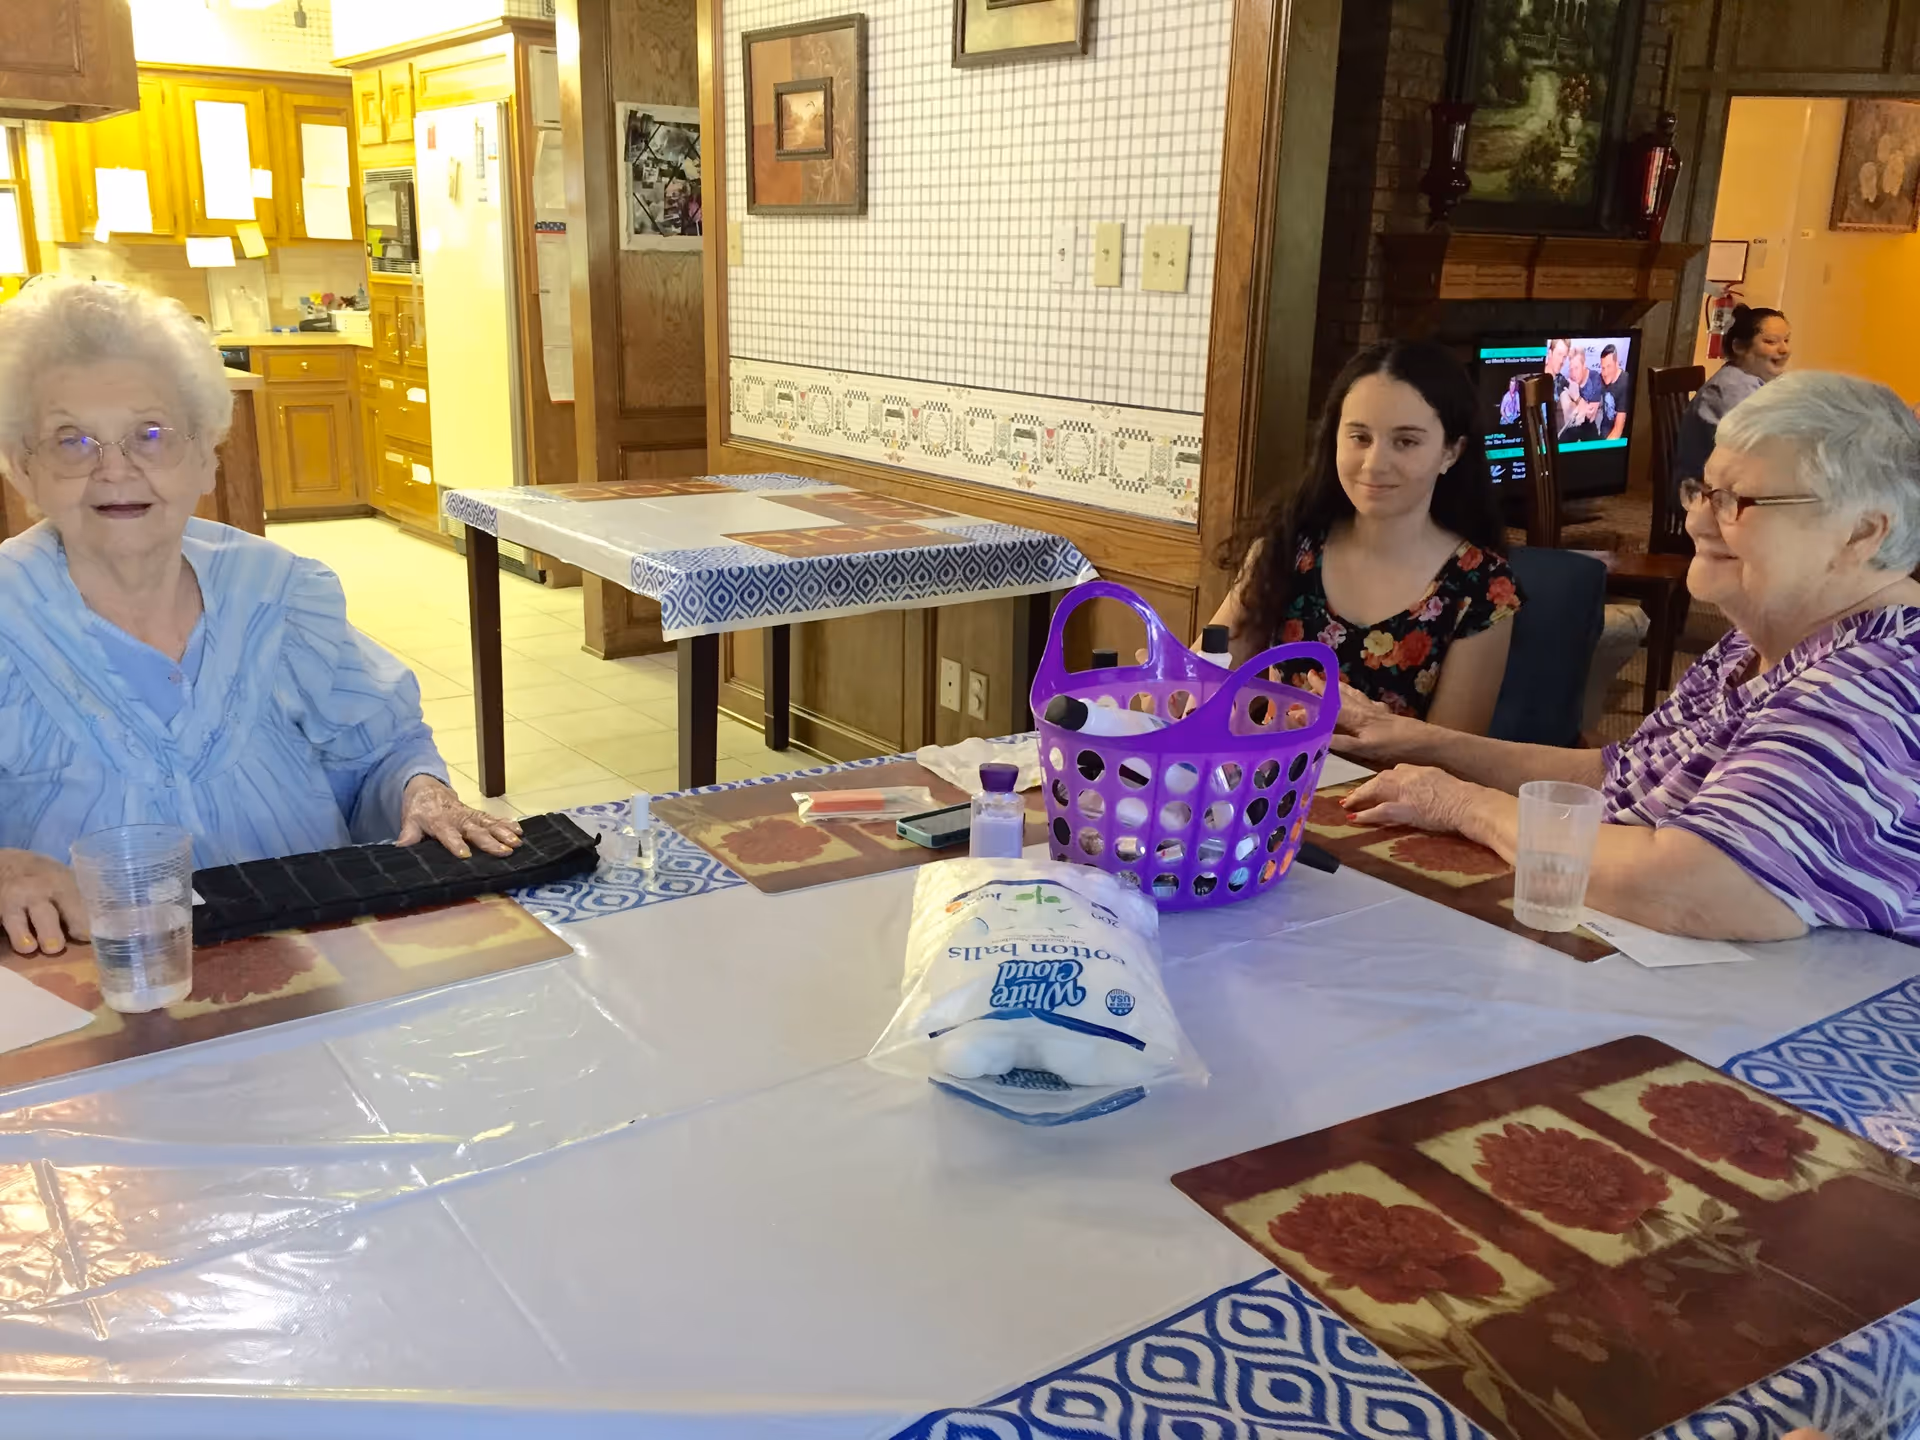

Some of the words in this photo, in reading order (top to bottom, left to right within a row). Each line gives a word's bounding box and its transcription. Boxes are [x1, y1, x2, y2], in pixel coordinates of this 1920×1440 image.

[947, 944, 1018, 961] balls
[1029, 943, 1125, 965] cotton
[995, 961, 1080, 986] Cloud
[991, 981, 1083, 1011] White
[1109, 995, 1131, 1003] USA
